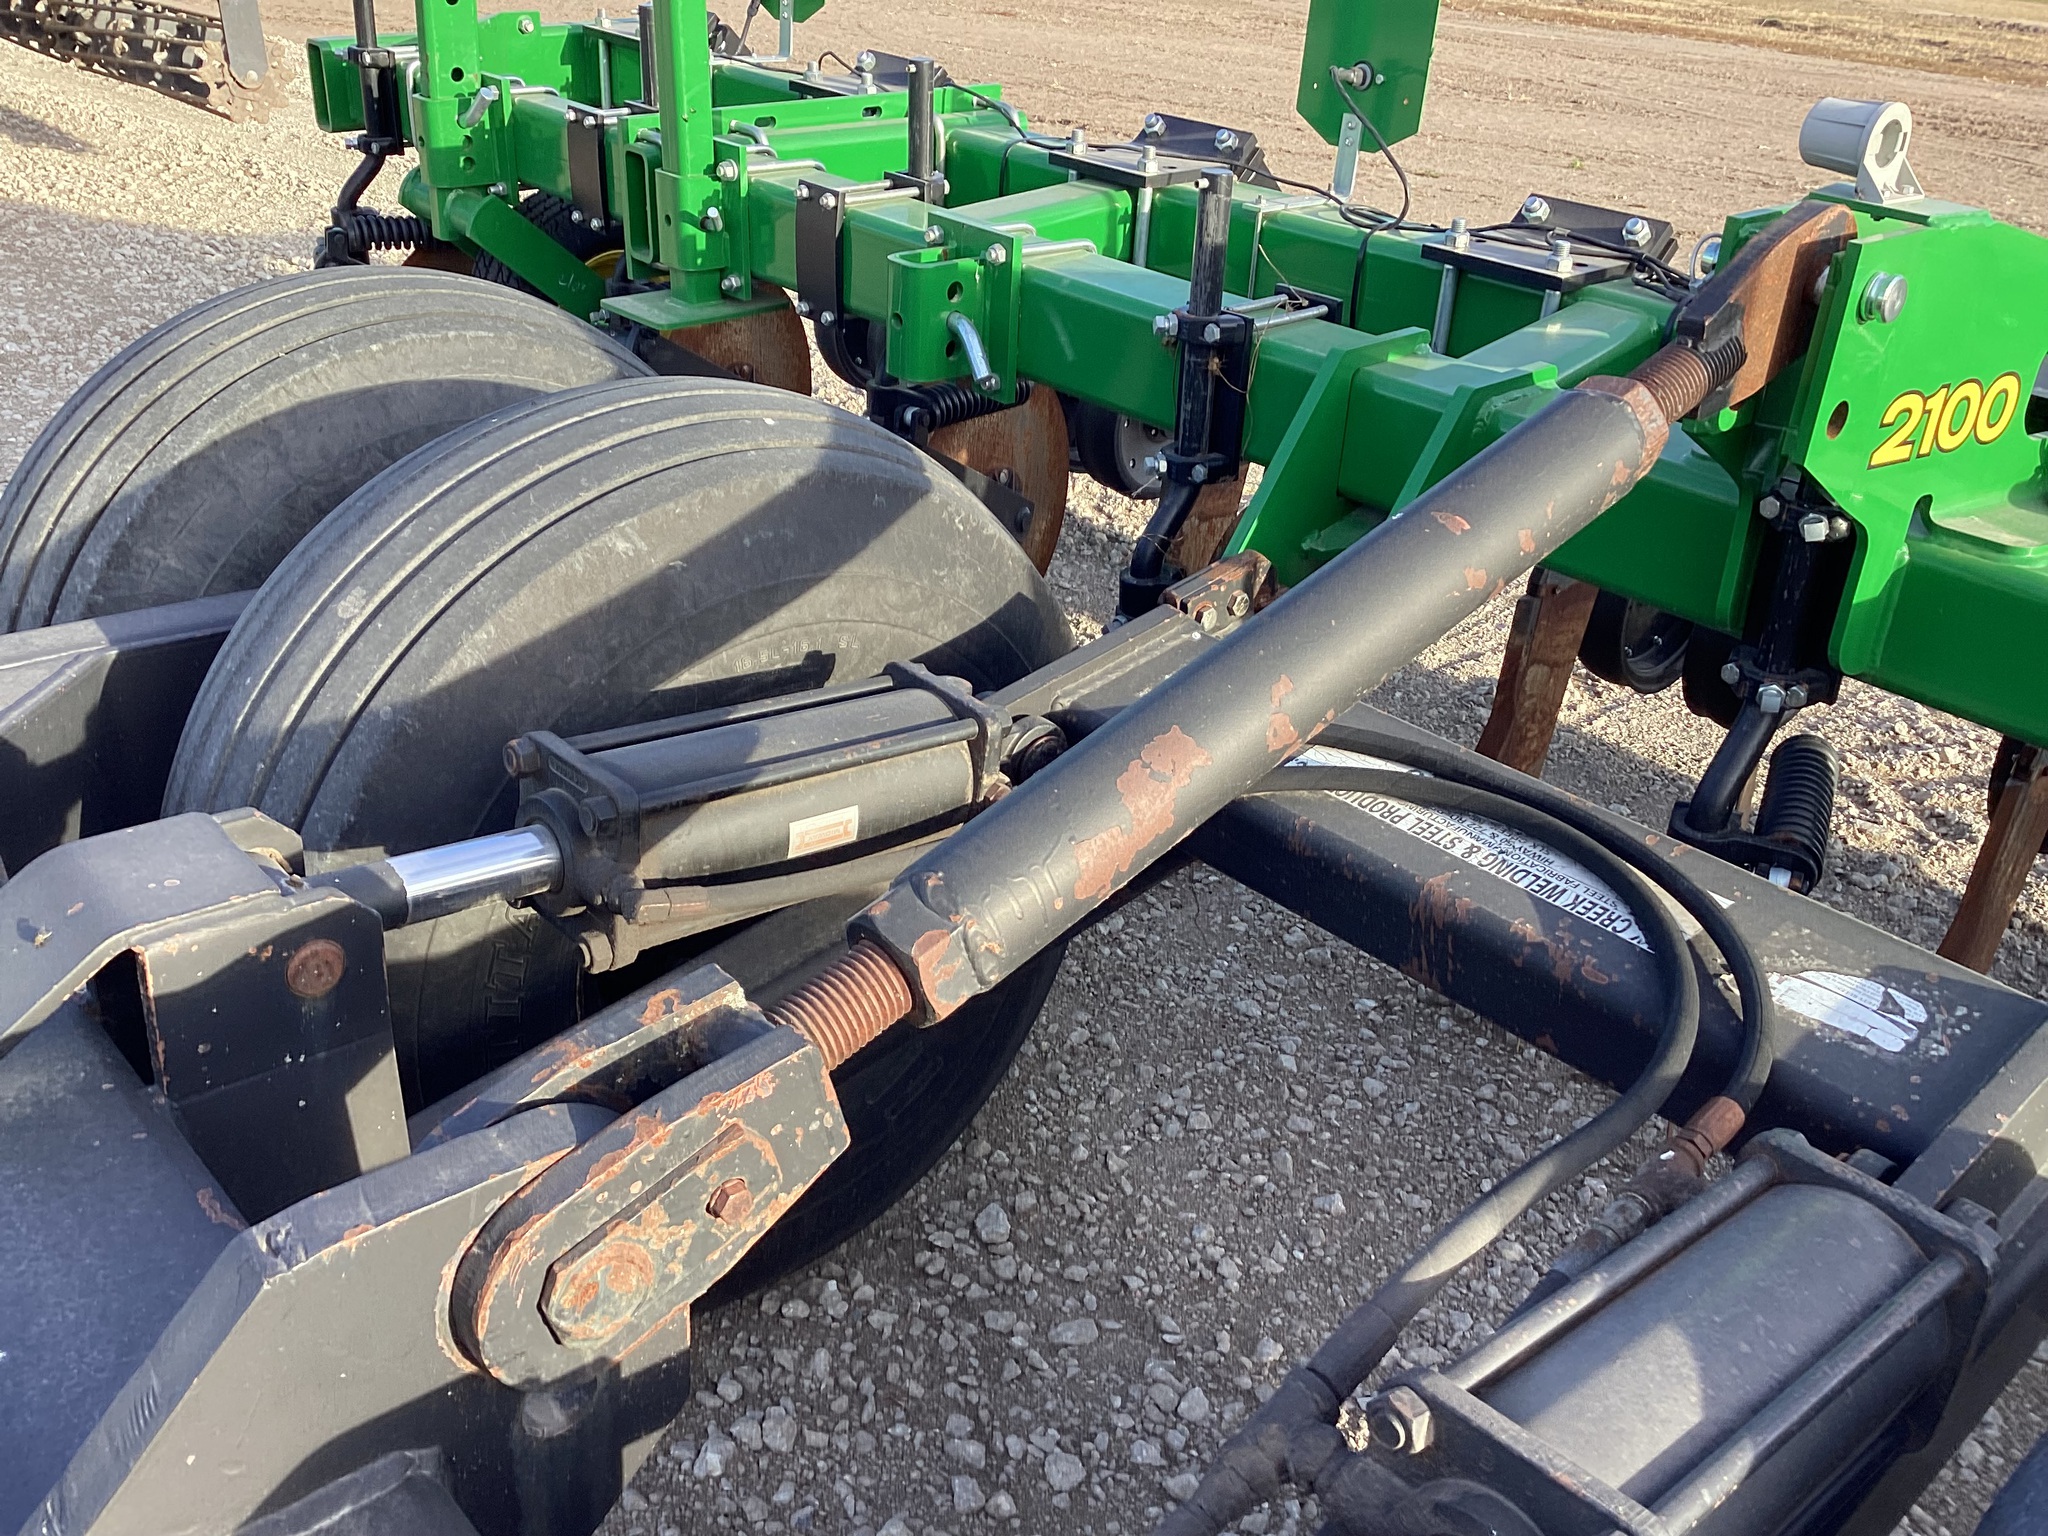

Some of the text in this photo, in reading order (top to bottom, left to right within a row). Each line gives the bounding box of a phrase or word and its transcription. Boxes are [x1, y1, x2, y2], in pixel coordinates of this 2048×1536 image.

[1867, 371, 2022, 470] 2100
[1407, 817, 1463, 850] STEEL
[1461, 842, 1482, 860] &
[1478, 853, 1571, 904] WELDING
[1569, 893, 1633, 934] CREEK
[482, 904, 541, 1072] TITA
